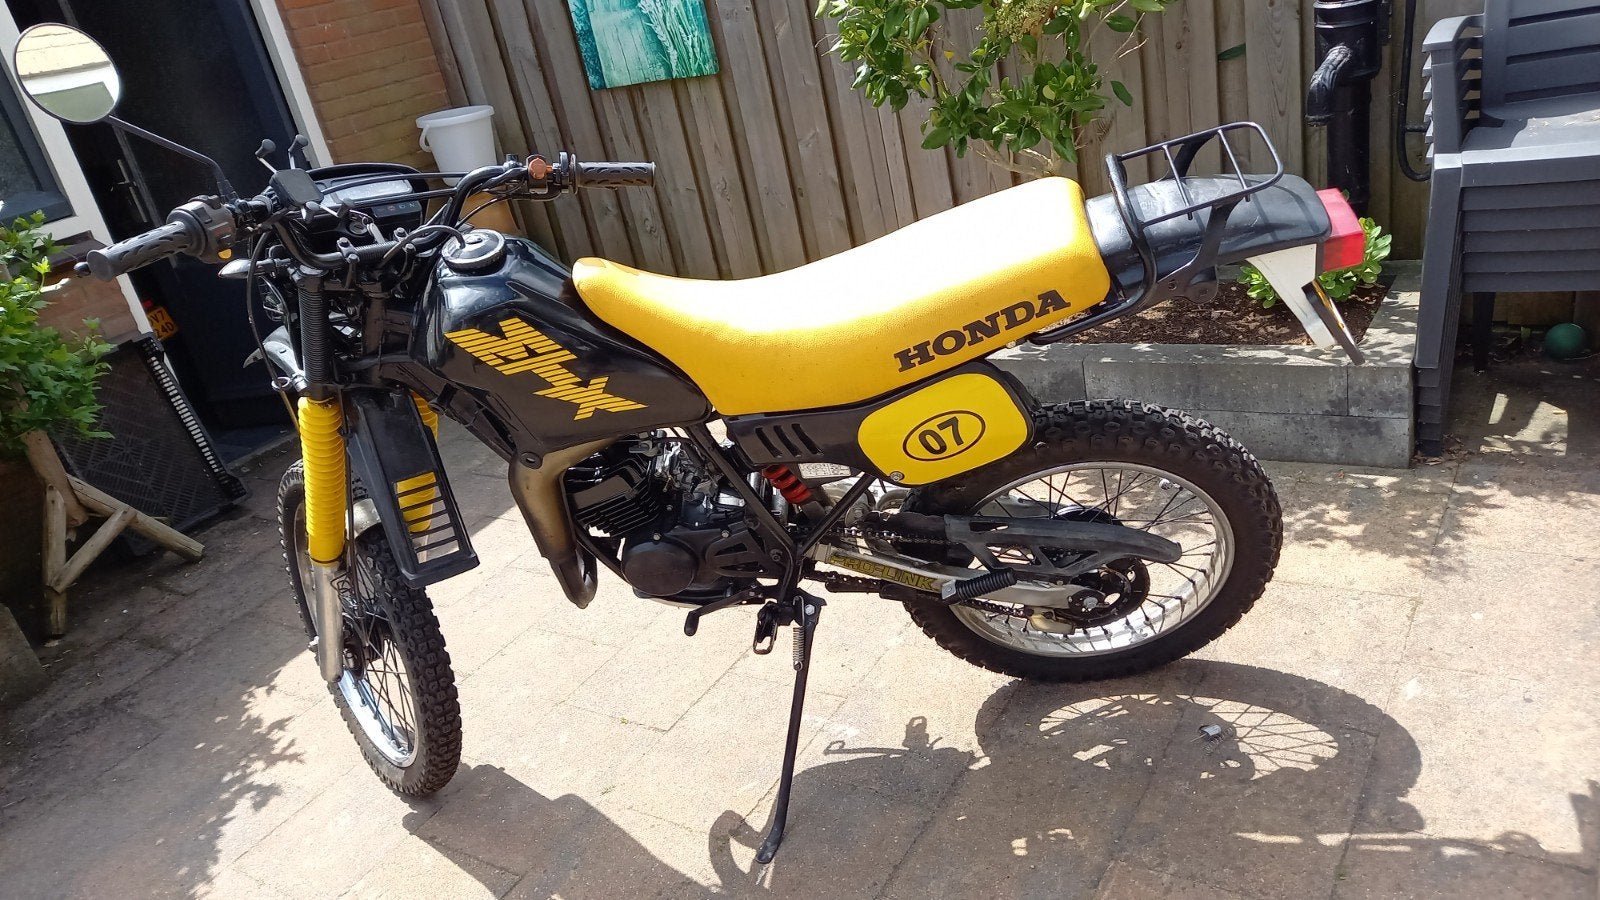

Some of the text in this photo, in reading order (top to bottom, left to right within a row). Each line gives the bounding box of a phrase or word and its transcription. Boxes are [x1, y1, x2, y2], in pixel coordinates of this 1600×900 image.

[444, 317, 649, 421] MTX
[893, 289, 1071, 373] HONDA
[918, 416, 964, 455] 07
